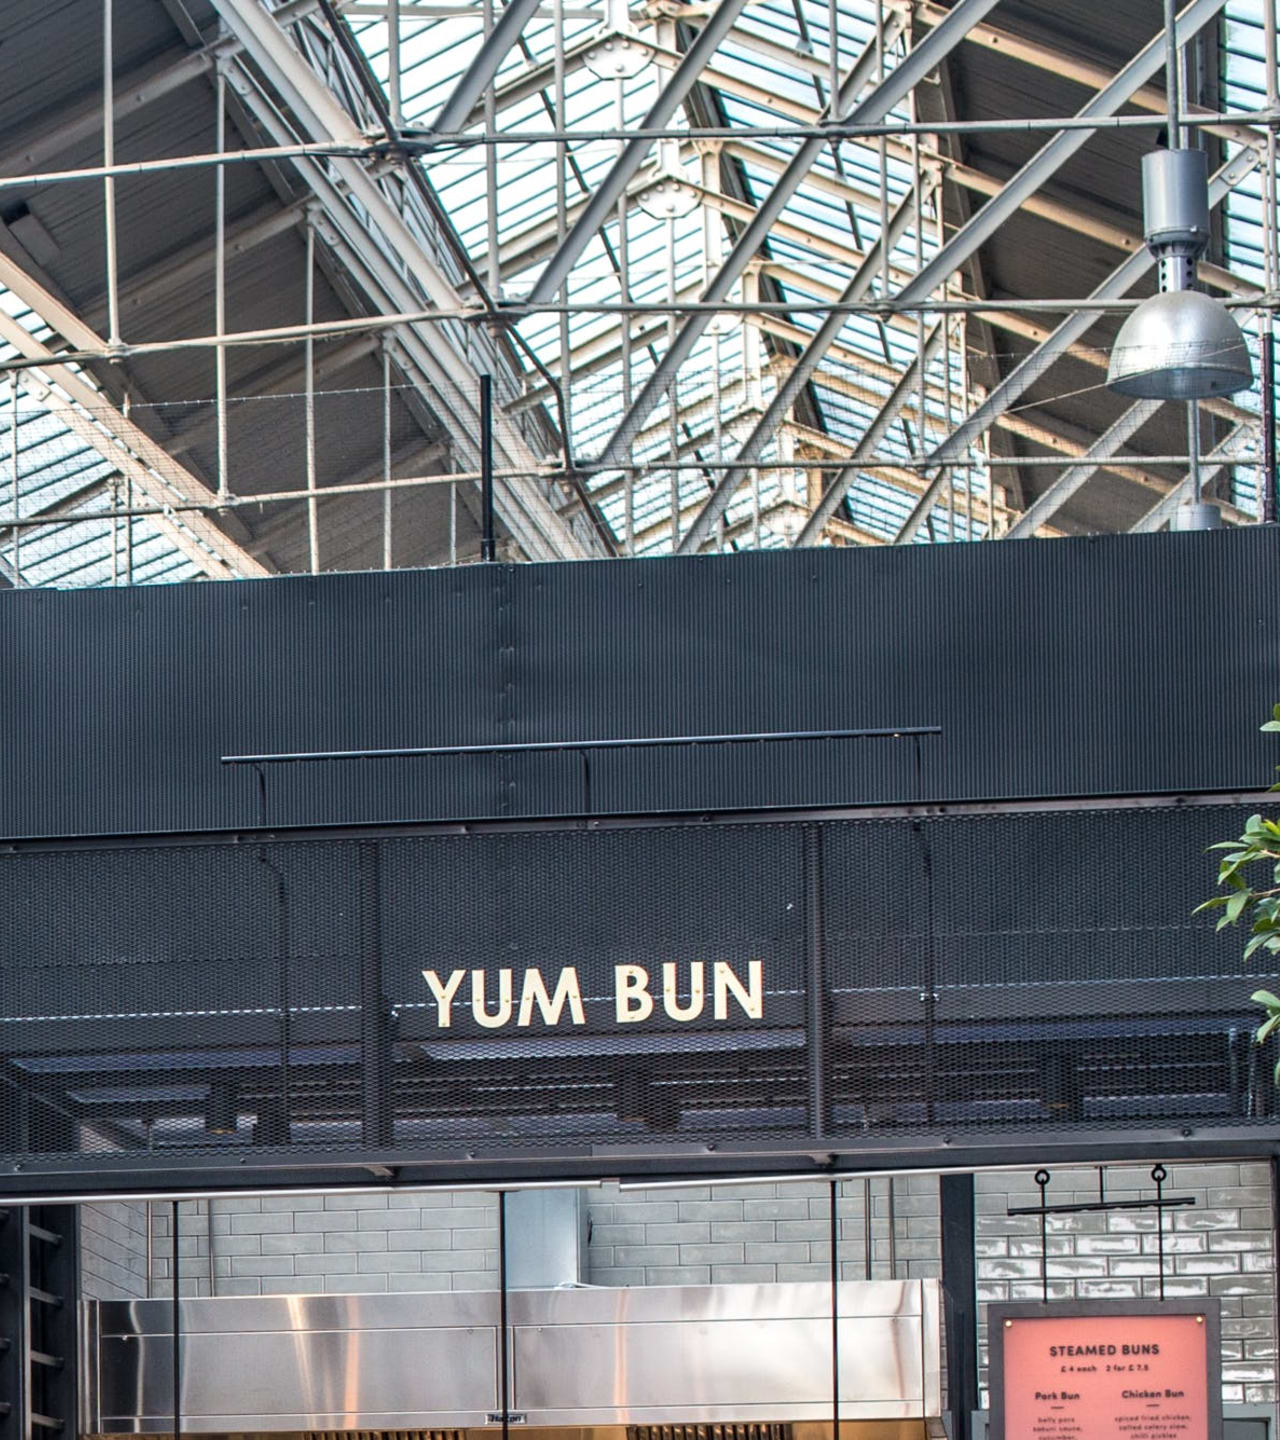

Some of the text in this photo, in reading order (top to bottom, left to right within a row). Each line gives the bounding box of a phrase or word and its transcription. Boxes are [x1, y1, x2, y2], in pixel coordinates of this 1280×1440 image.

[421, 960, 763, 1029] YUM BUN
[1049, 1343, 1160, 1356] STEAMED BUNS
[1077, 1364, 1097, 1372] each
[1113, 1364, 1126, 1372] for
[1034, 1391, 1081, 1401] Pork Bun
[1121, 1389, 1184, 1398] Chicken Bun
